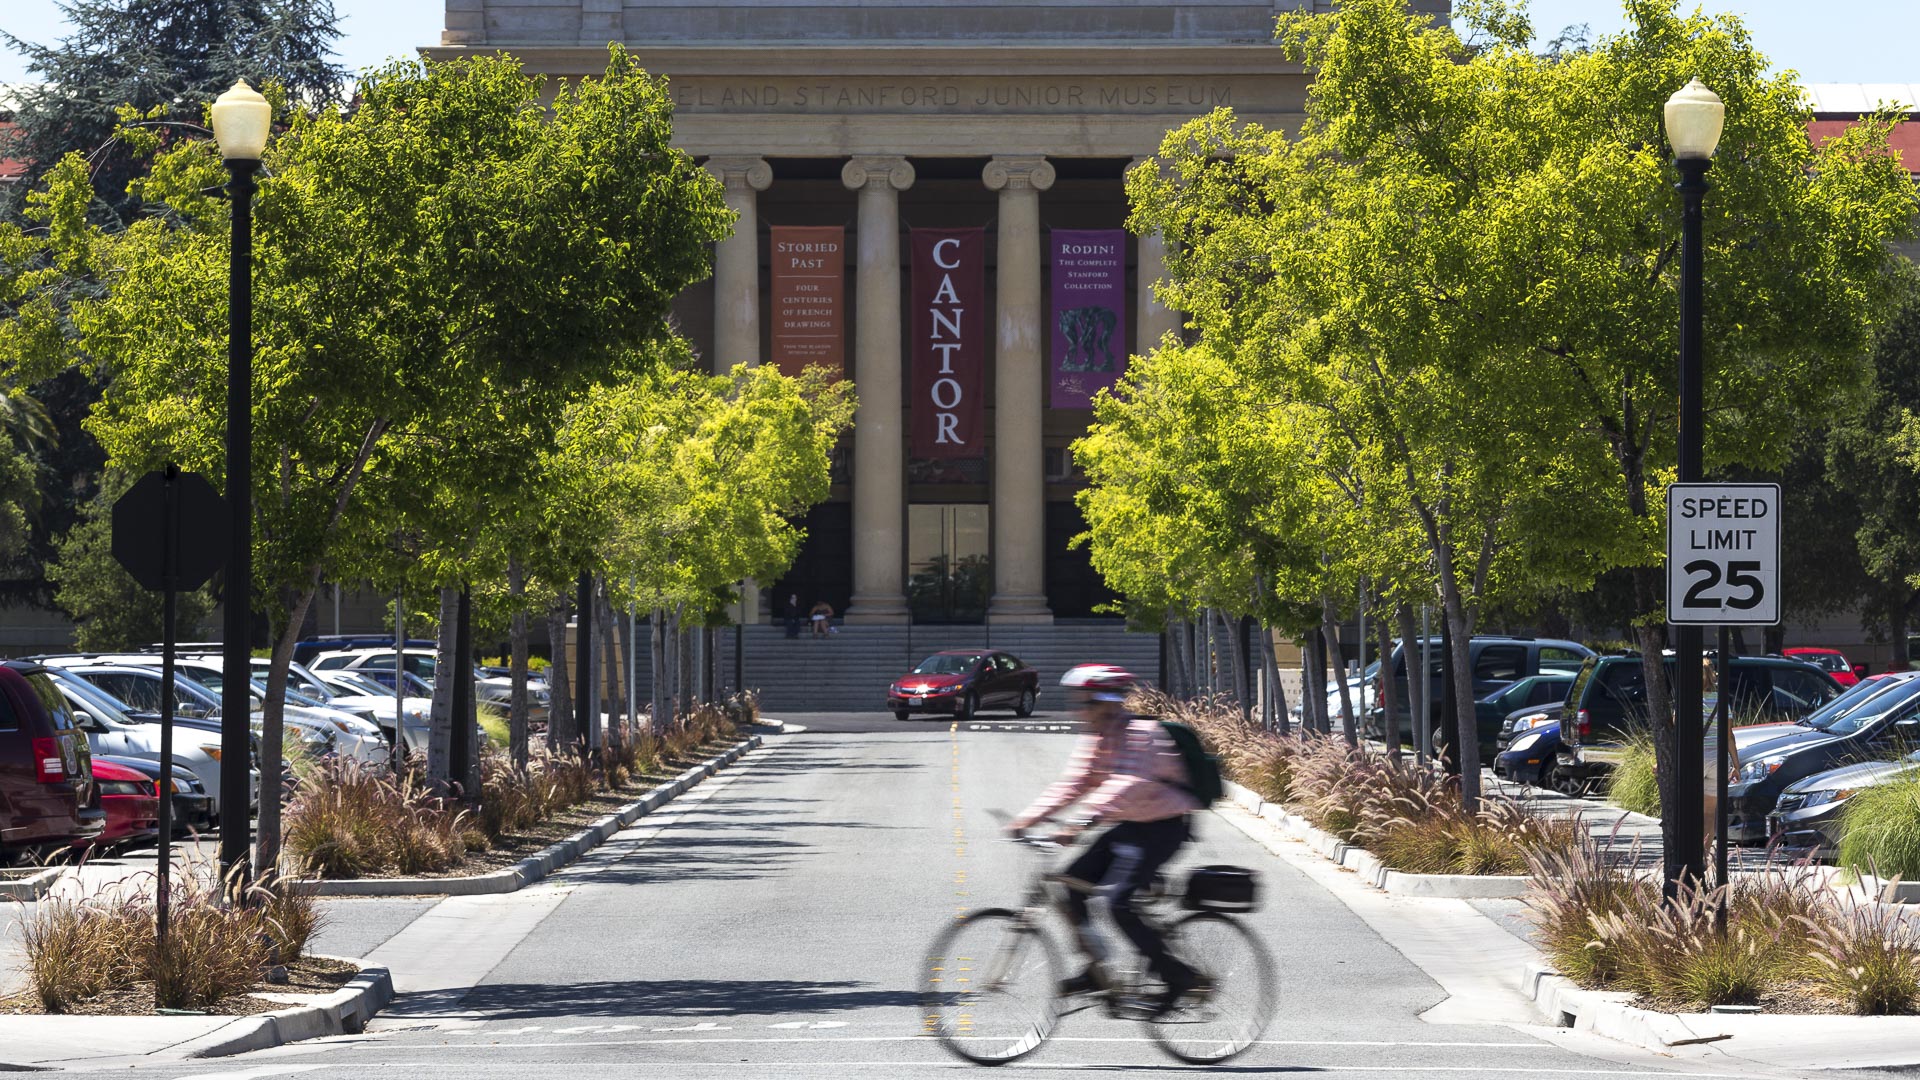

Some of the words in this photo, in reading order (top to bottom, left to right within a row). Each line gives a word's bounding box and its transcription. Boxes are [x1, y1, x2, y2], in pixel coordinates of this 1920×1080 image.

[677, 86, 779, 106] ELAND
[793, 86, 960, 106] STANFORD
[975, 85, 1084, 105] JUNIOR
[1099, 85, 1232, 105] MUSEUM
[777, 242, 838, 253] STORIED
[1062, 244, 1114, 255] RODIN!
[791, 257, 824, 269] PAST
[1077, 259, 1118, 267] COMPLETE
[1067, 271, 1109, 279] STANFORD
[795, 284, 819, 292] FOUR
[1063, 282, 1113, 291] COLLECTION
[782, 296, 833, 304] CENTURIES
[782, 309, 795, 317] OF
[797, 309, 832, 317] FRENCH
[783, 321, 832, 329] DRAWINGS
[929, 238, 965, 445] CANTOR
[1681, 498, 1768, 519] SPEED
[1690, 529, 1757, 550] LIMIT
[1682, 559, 1765, 610] 25
